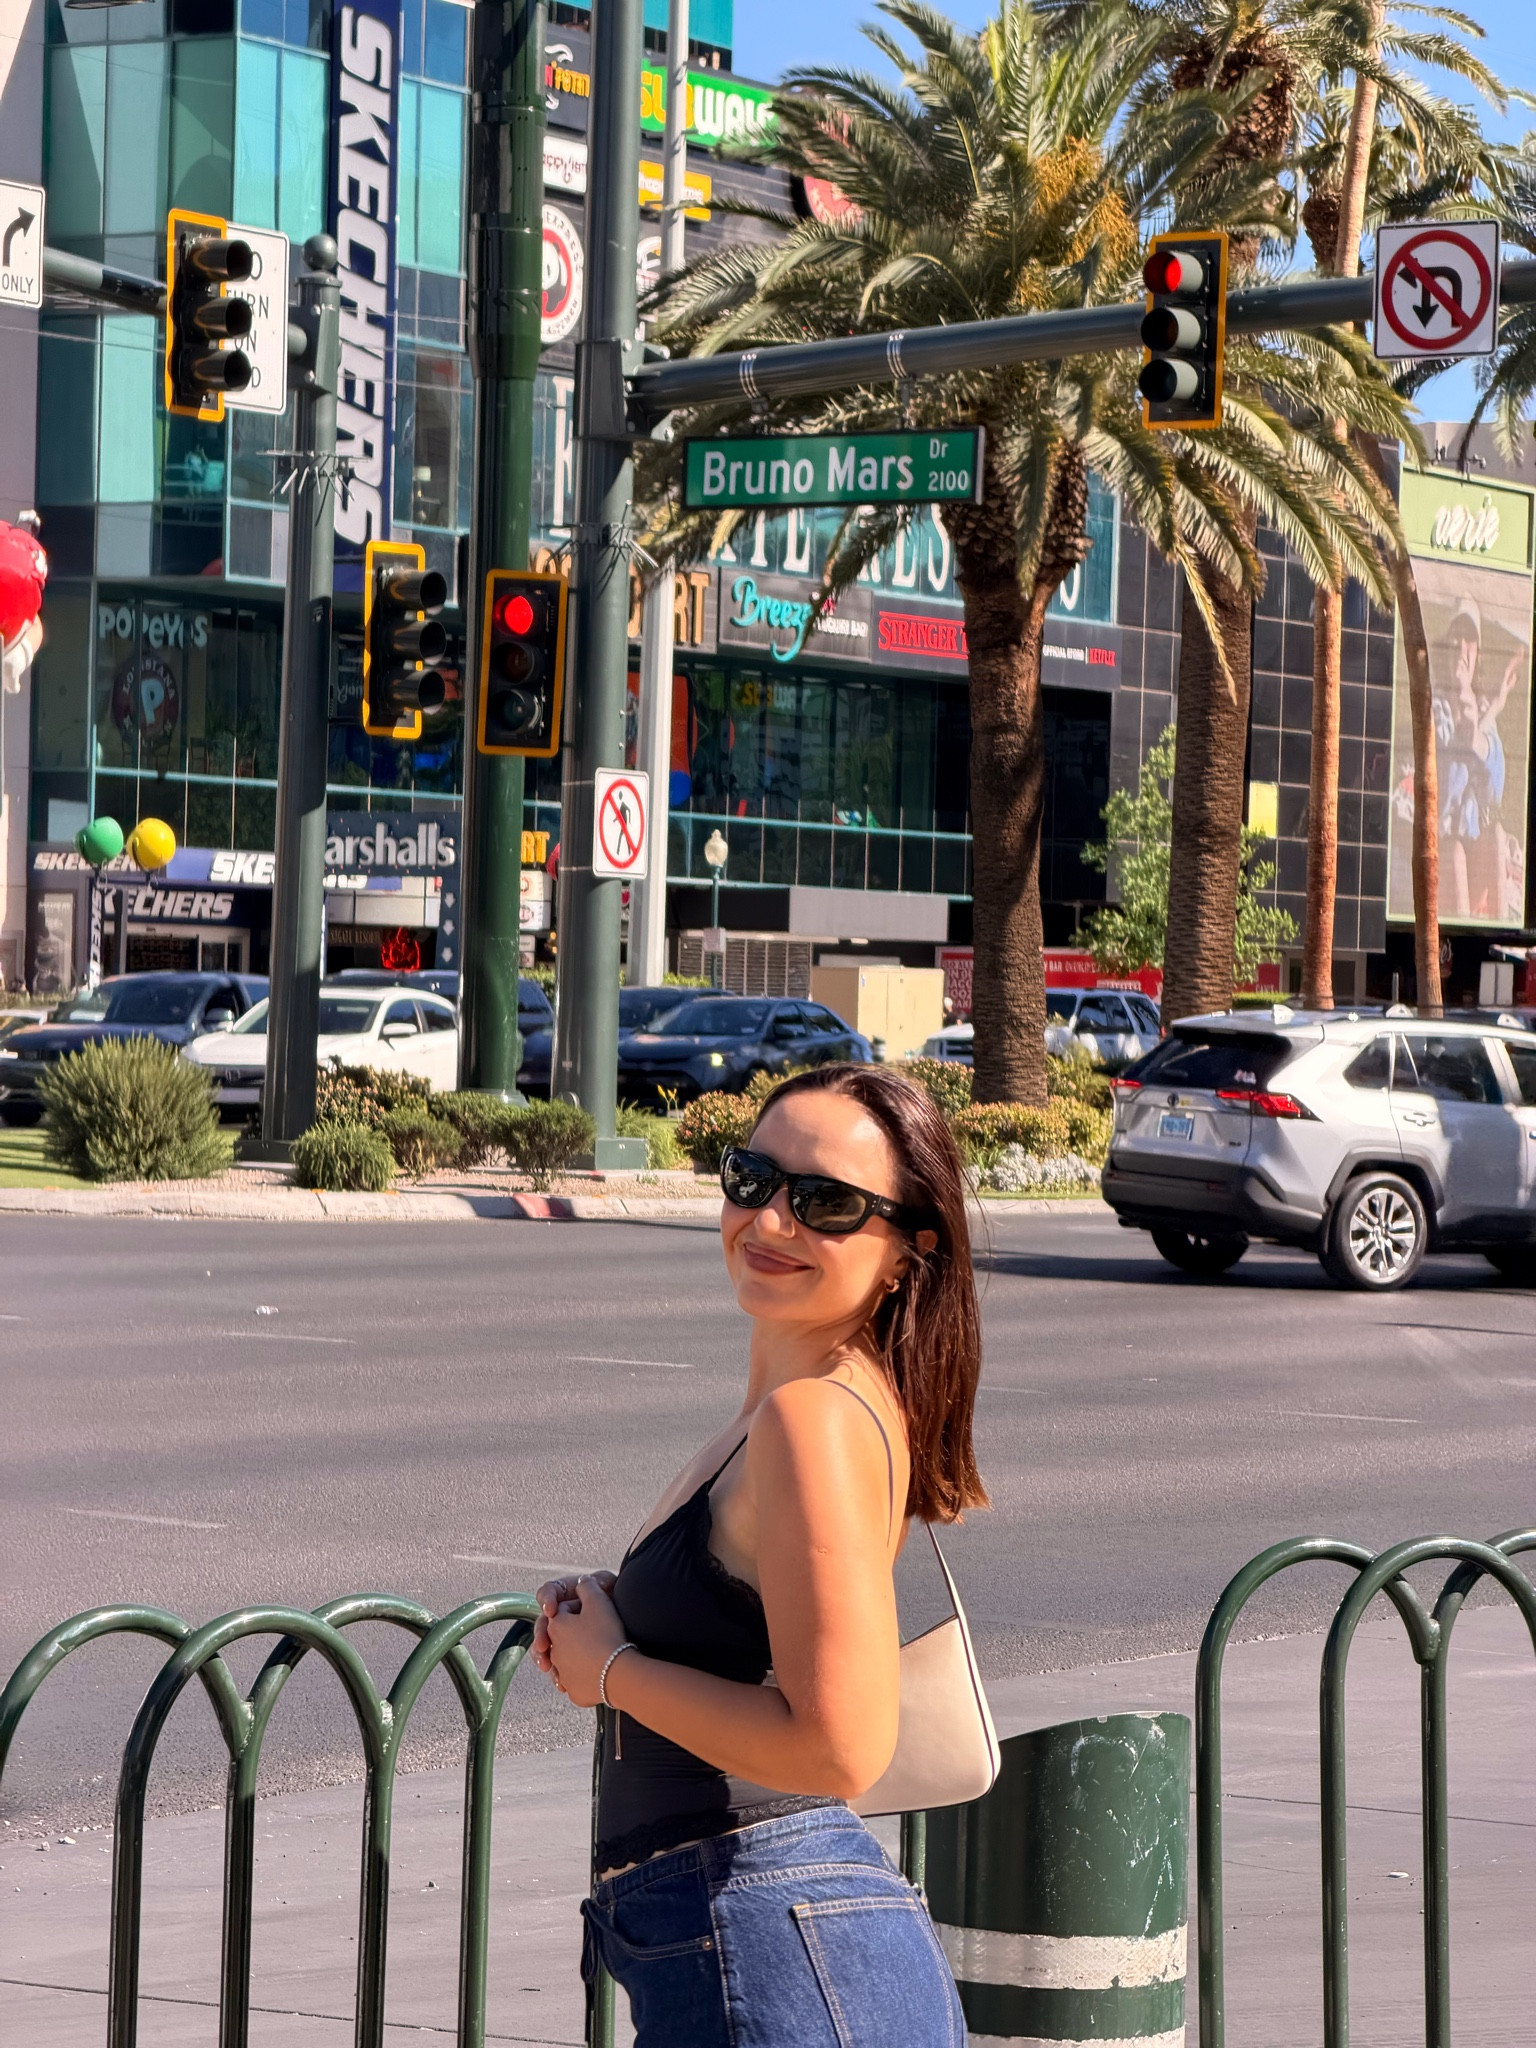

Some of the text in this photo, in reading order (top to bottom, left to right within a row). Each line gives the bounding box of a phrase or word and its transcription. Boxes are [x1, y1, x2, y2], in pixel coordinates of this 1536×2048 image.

[2, 276, 35, 295] ONLY
[333, 5, 393, 546] SKECHERS
[929, 438, 949, 459] Dr
[703, 446, 914, 496] Bruno Mars
[928, 470, 969, 492] 2100
[878, 617, 957, 655] STRANGER
[1089, 648, 1115, 667] NETFLIX
[141, 678, 165, 724] P
[324, 821, 456, 867] arshalls
[520, 831, 550, 863] RT
[210, 852, 276, 885] SKE
